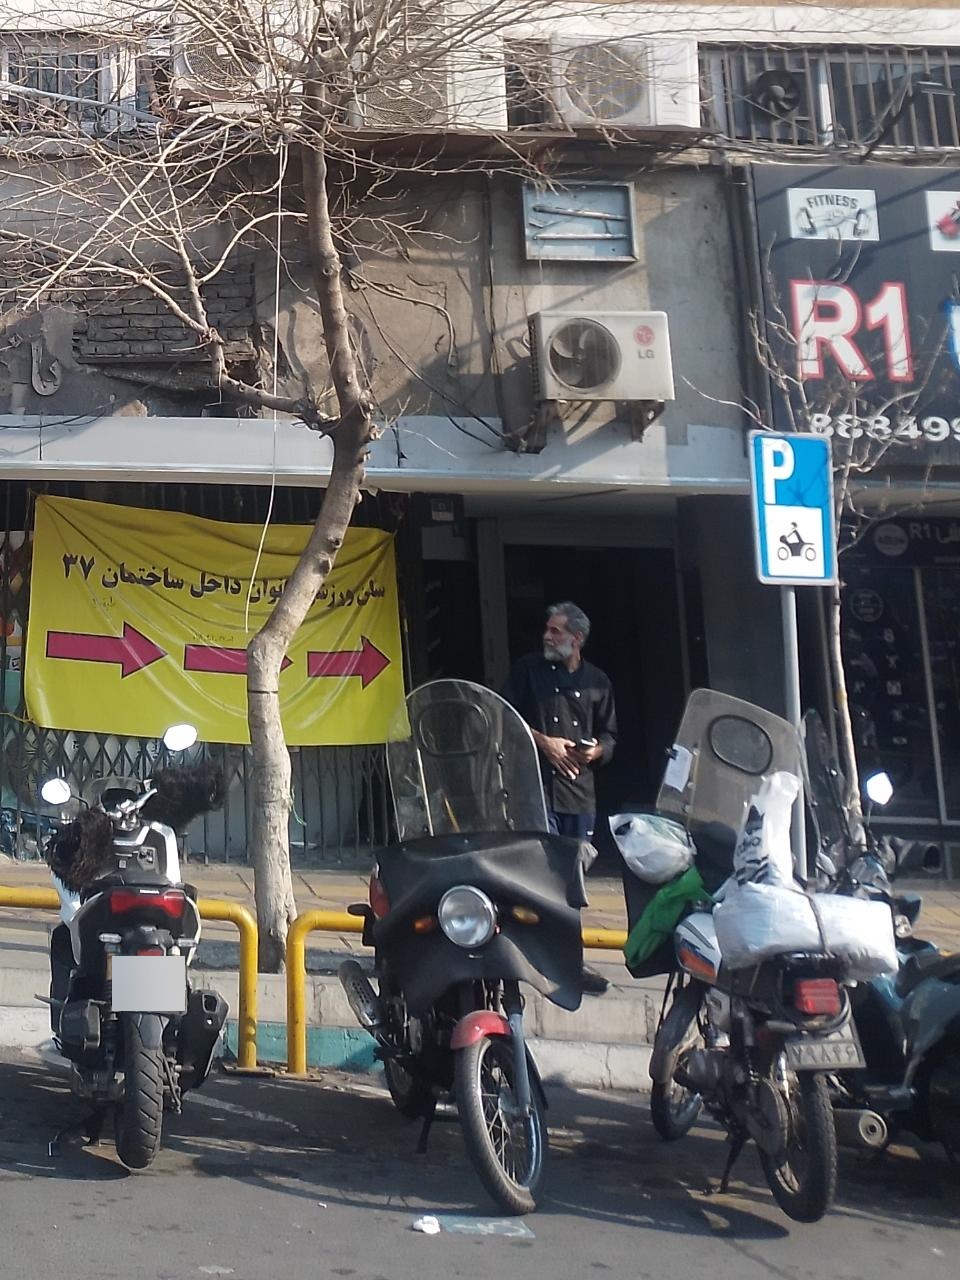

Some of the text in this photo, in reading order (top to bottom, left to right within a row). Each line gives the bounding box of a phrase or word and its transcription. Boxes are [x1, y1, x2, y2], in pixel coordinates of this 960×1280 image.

[806, 194, 858, 209] FITNESS
[790, 279, 914, 383] R1
[761, 437, 796, 505] P
[62, 553, 95, 581] ۳۷
[101, 562, 185, 589] ساختمان
[312, 583, 355, 608] ورزش
